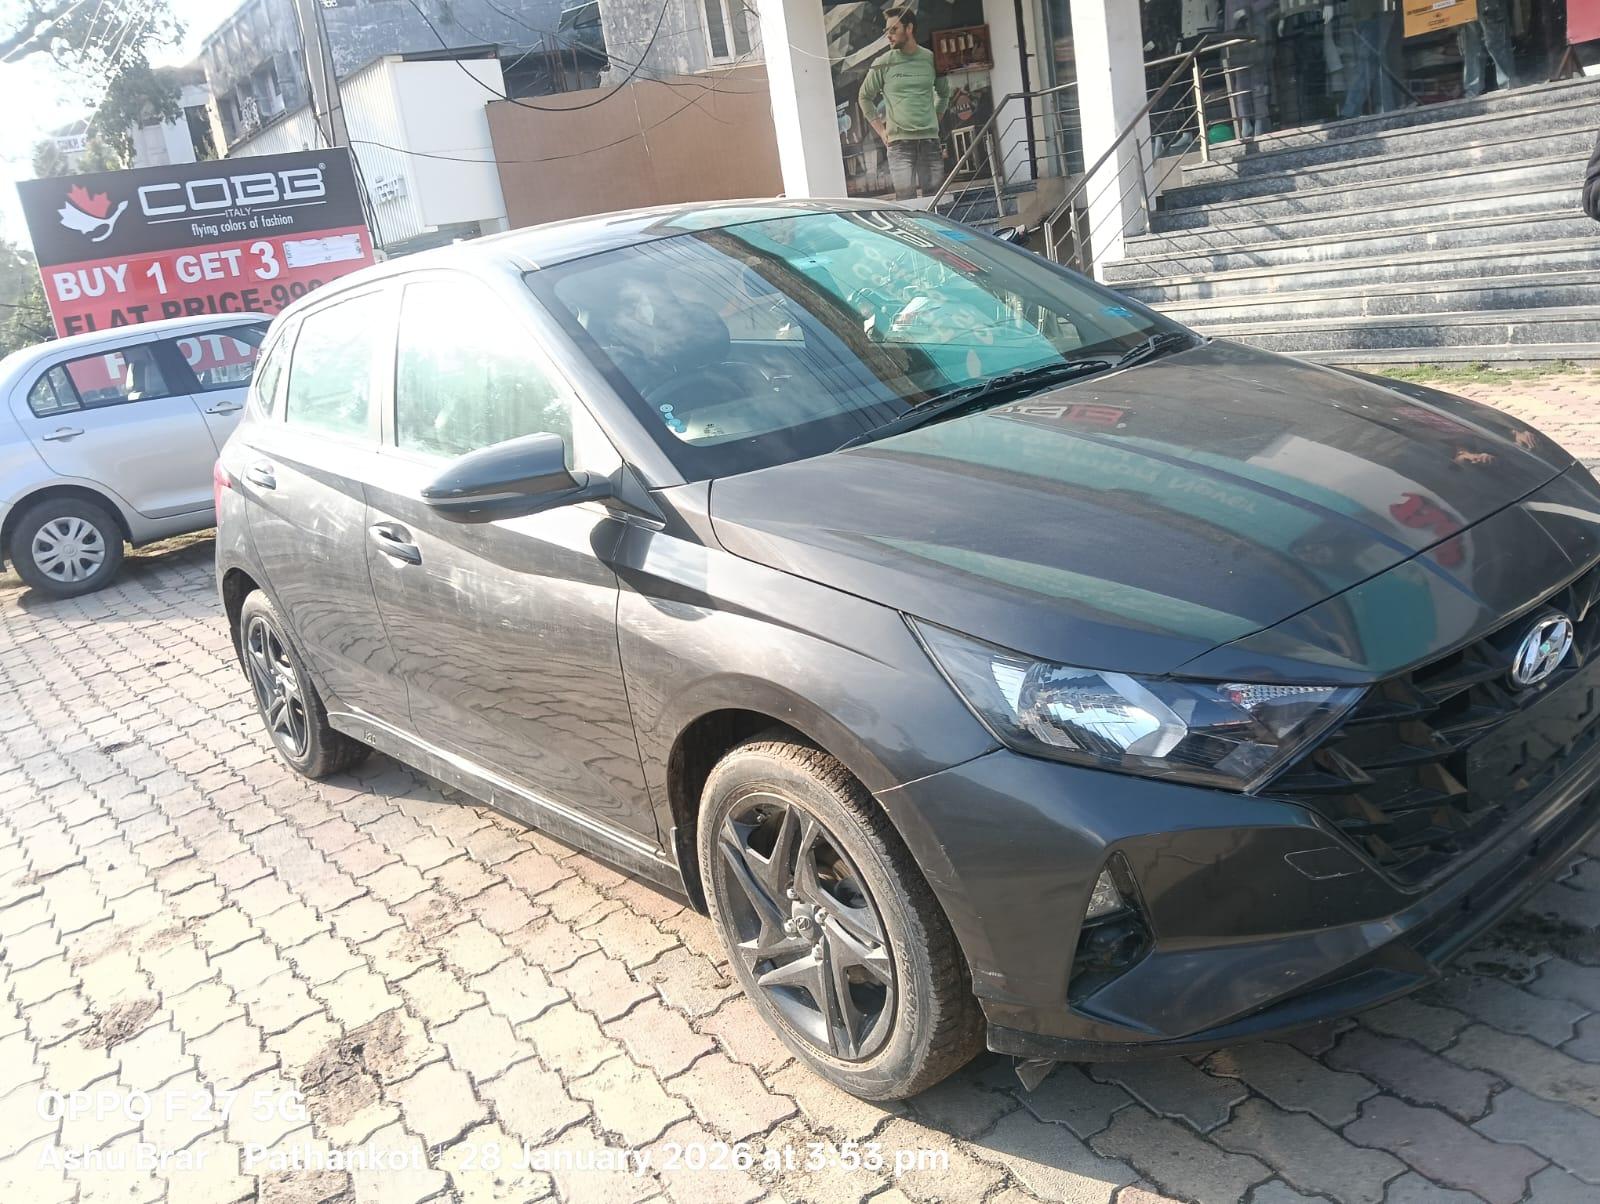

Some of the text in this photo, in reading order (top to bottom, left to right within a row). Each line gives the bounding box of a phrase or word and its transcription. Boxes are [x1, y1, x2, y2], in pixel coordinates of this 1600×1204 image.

[137, 168, 326, 216] COBB
[191, 214, 294, 238] flying colors of fashion
[224, 207, 252, 218] ITALY
[52, 241, 280, 301] BUY 1 GET 3
